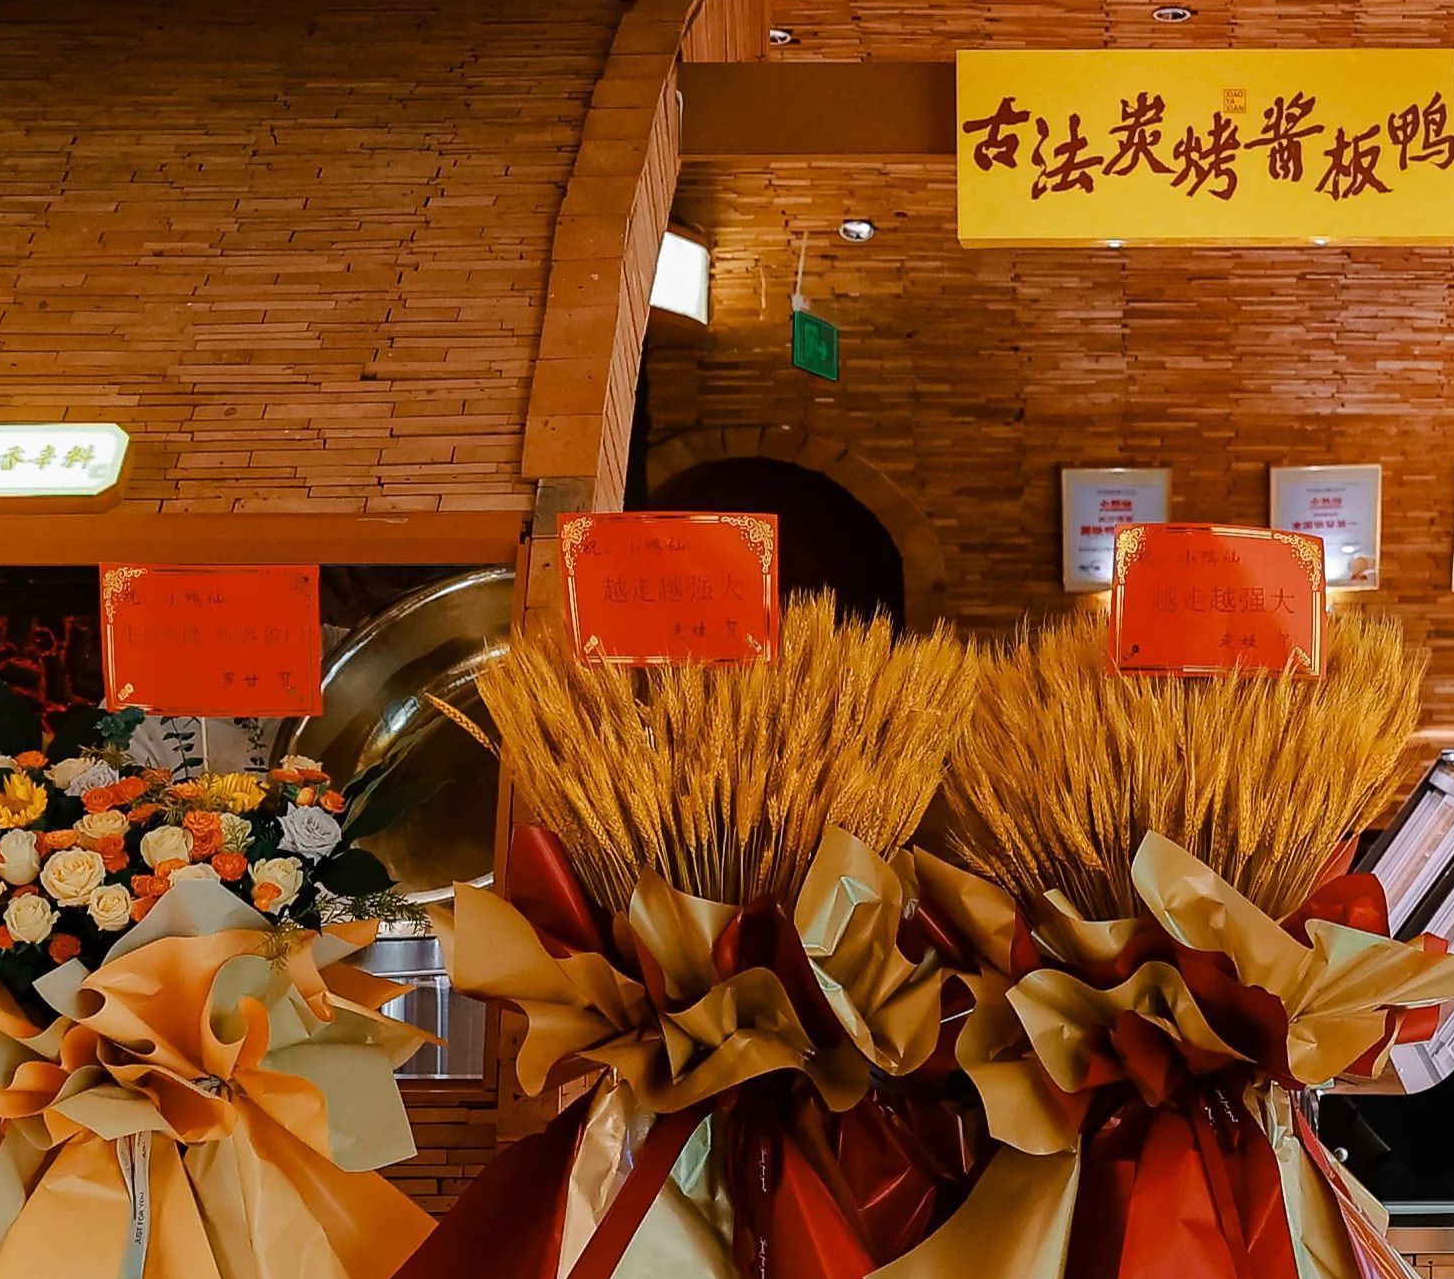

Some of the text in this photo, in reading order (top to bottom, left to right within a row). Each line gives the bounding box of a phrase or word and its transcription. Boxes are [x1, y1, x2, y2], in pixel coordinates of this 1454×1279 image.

[602, 574, 743, 603] 越走越强大
[1153, 585, 1295, 614] 越走越强大
